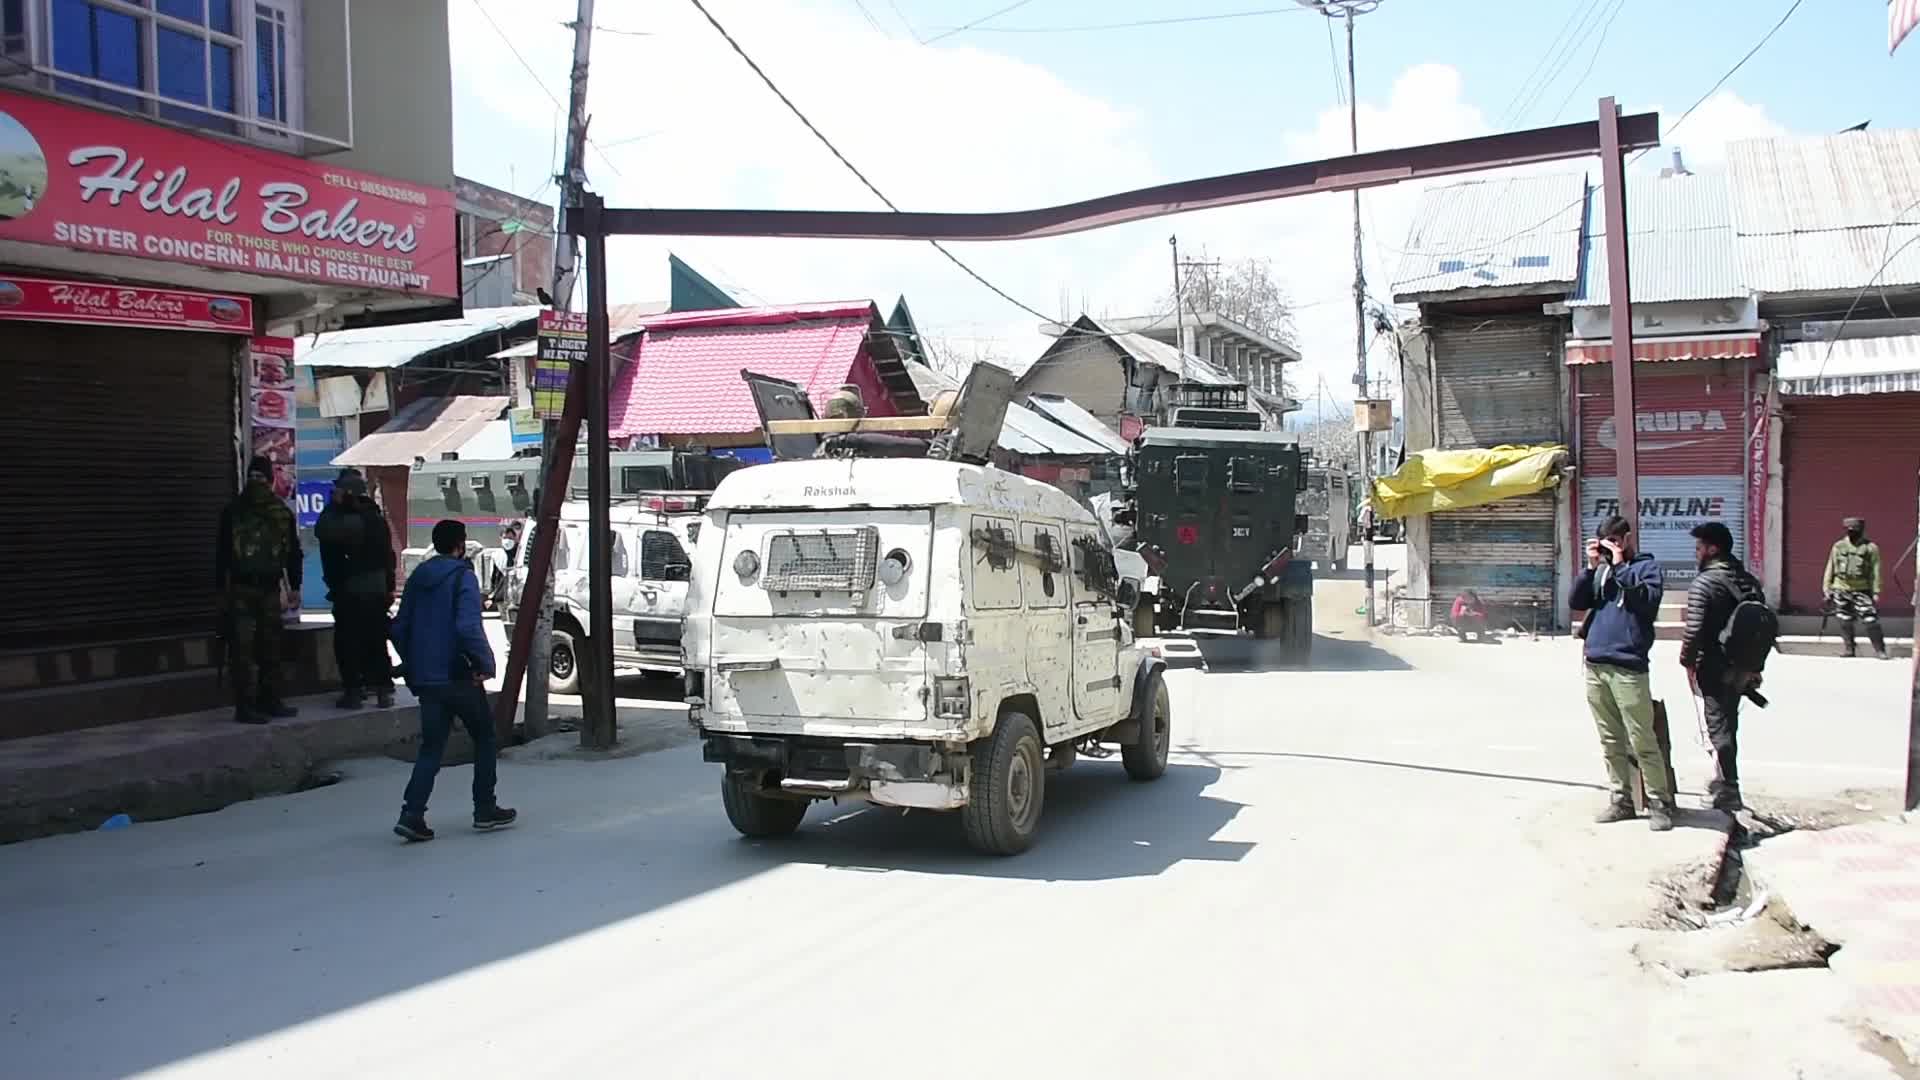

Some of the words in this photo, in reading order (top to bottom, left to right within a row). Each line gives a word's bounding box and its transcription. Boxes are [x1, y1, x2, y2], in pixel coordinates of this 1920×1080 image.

[68, 146, 241, 226] Hilal
[258, 182, 418, 253] Bakers
[53, 222, 138, 251] SISTER
[143, 236, 250, 266] CONCERN:
[255, 251, 321, 276] MAJLIS
[206, 229, 233, 245] FOR
[238, 234, 279, 252] THOSE
[281, 241, 310, 257] WHO
[313, 246, 361, 264] CHOOSE
[363, 254, 386, 268] THE
[387, 258, 415, 271] BEST
[48, 285, 111, 306] Hilal
[116, 290, 184, 312] Bakers
[1635, 410, 1727, 432] RUPA
[803, 485, 857, 497] Rakshak
[1594, 497, 1724, 516] FRNTLINE
